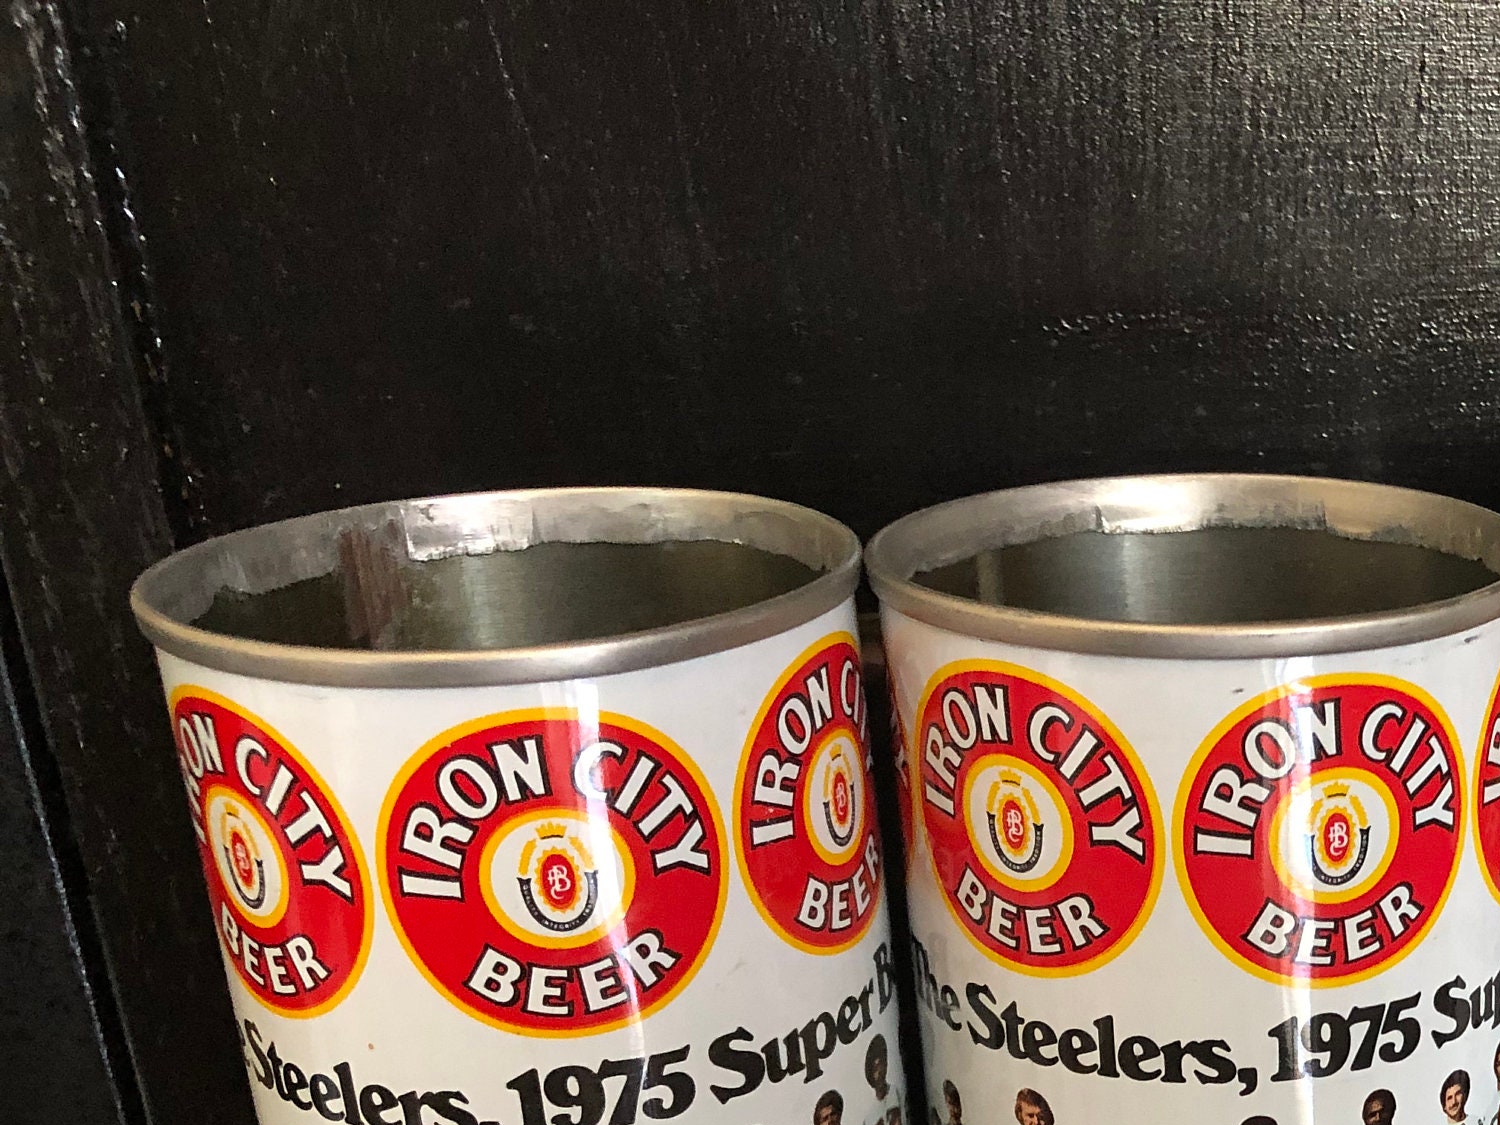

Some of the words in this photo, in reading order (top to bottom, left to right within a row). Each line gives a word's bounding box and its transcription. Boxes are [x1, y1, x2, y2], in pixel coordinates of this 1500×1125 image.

[751, 662, 833, 848] IRON
[924, 682, 1012, 817] IRON
[1026, 701, 1146, 865] CITY
[1193, 697, 1342, 861] IRON
[1358, 699, 1454, 832] CITY
[235, 737, 355, 905] CITY
[397, 735, 553, 902] IRON
[572, 739, 712, 876] CITY
[796, 832, 880, 933] BEER
[954, 863, 1111, 956] BEER
[1240, 881, 1425, 968] BEER
[219, 902, 333, 997] BEER
[462, 929, 682, 1017] BEER
[708, 976, 874, 1105] Super
[965, 982, 1258, 1097] Steelers,
[1267, 991, 1422, 1083] 1975
